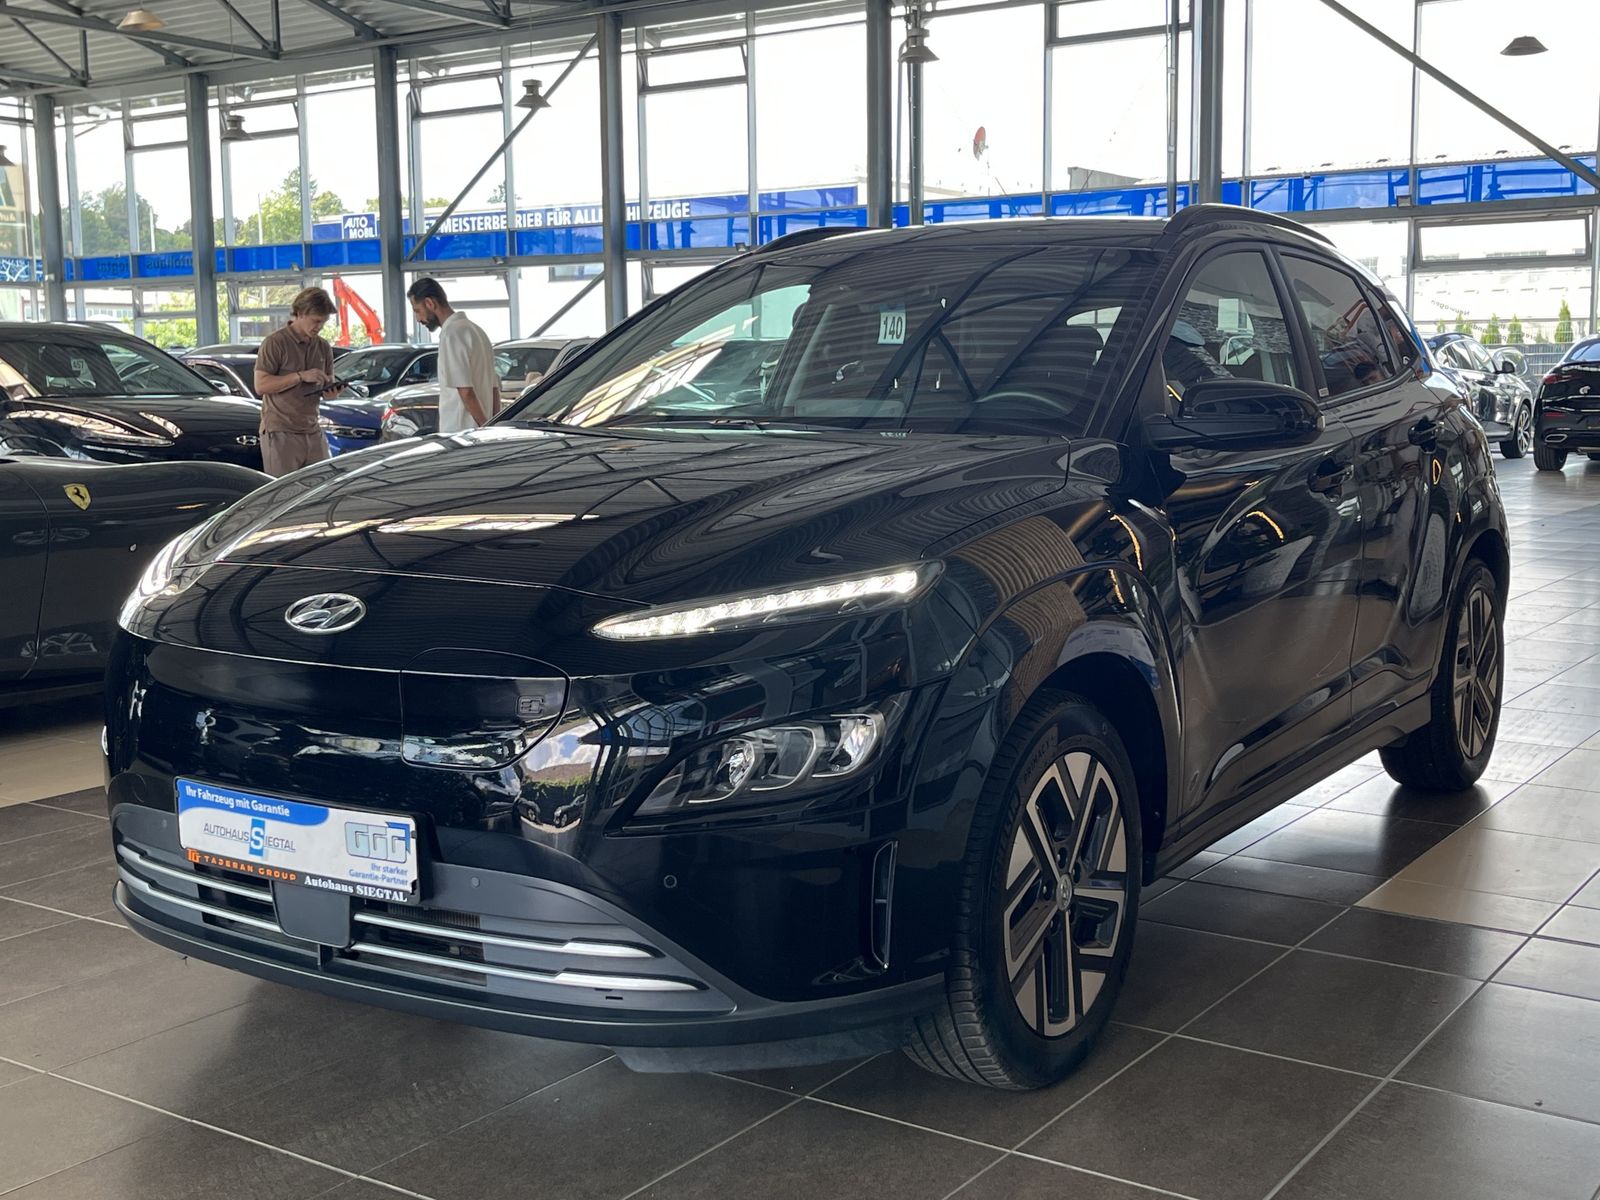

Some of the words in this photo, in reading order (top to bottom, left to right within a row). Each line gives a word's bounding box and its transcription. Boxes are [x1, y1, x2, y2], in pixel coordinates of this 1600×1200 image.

[344, 216, 368, 229] AUTO
[424, 213, 542, 234] FZMEISTERBERIEB
[547, 208, 571, 226] FÜR
[349, 227, 375, 239] MOBIL
[883, 316, 903, 340] 140
[186, 785, 197, 798] Ihr
[198, 788, 235, 809] Fahrzeug
[235, 798, 250, 810] mit
[251, 800, 291, 817] Garantie
[203, 822, 250, 842] AUTOHAUS
[258, 867, 298, 881] GROUP
[349, 868, 408, 886] Garantie-Partner
[371, 863, 381, 872] Ihr
[382, 866, 408, 876] starker
[304, 875, 354, 894] Autohaus
[356, 884, 408, 903] SIEGTAL
